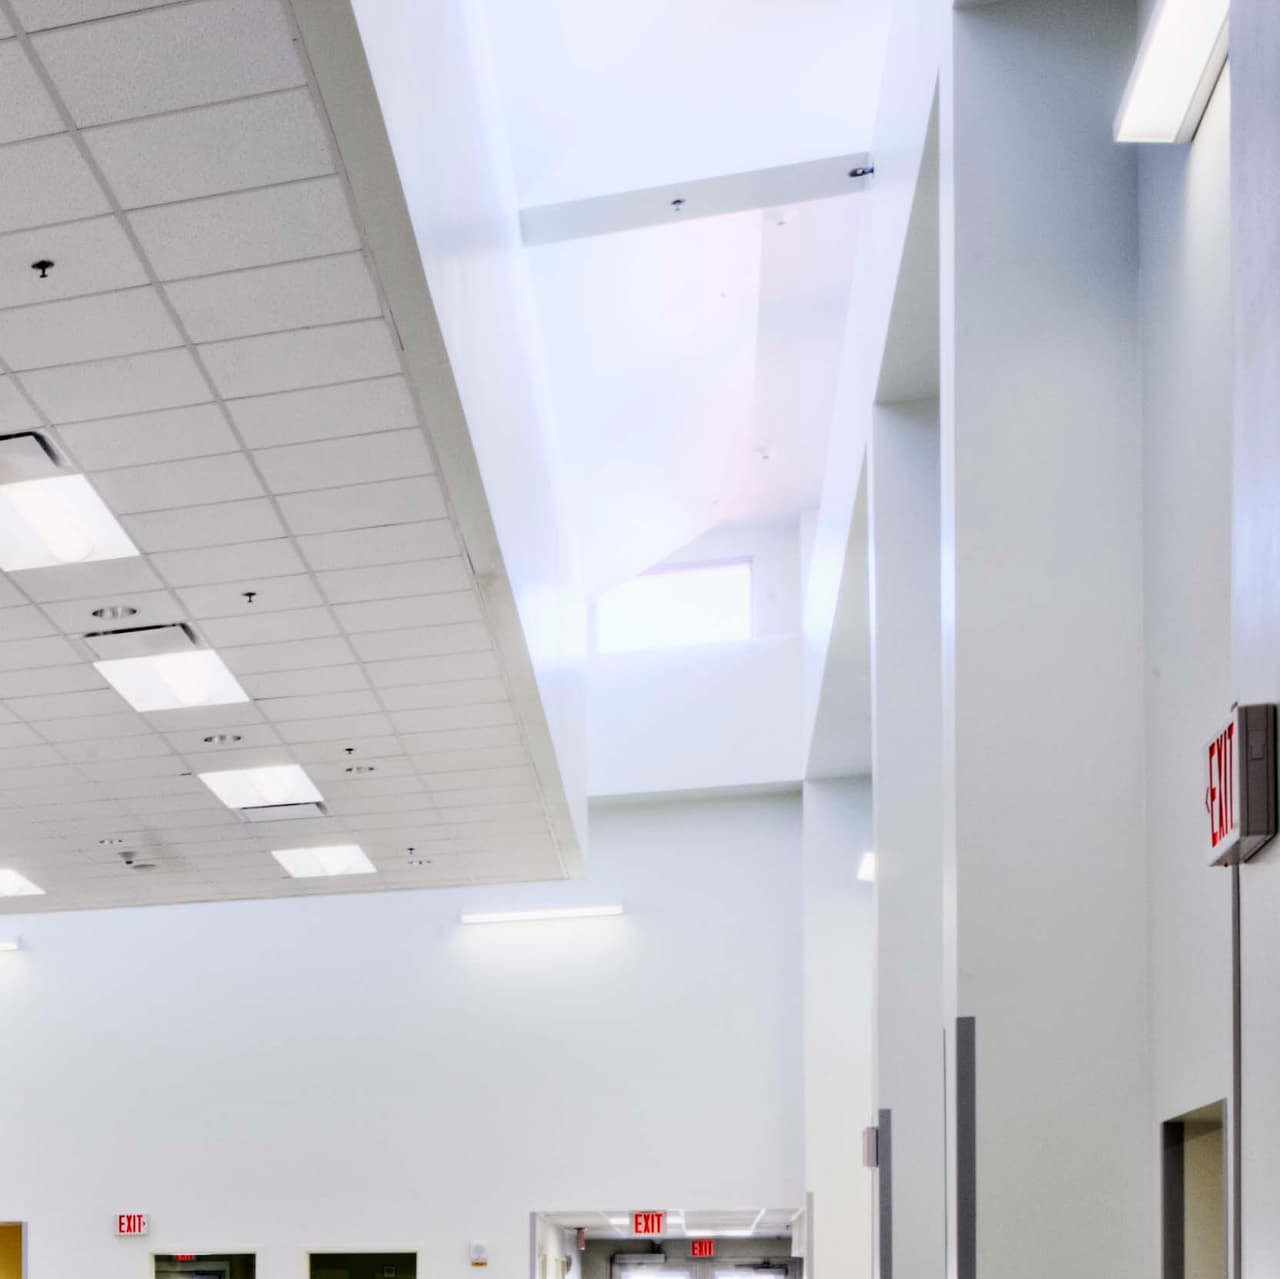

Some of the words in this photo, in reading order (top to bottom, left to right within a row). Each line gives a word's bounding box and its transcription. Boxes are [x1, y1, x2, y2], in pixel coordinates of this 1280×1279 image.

[1209, 721, 1235, 848] EXIT
[118, 1214, 143, 1234] EXIT
[634, 1212, 664, 1234] EXIT
[691, 1239, 715, 1257] EXIT
